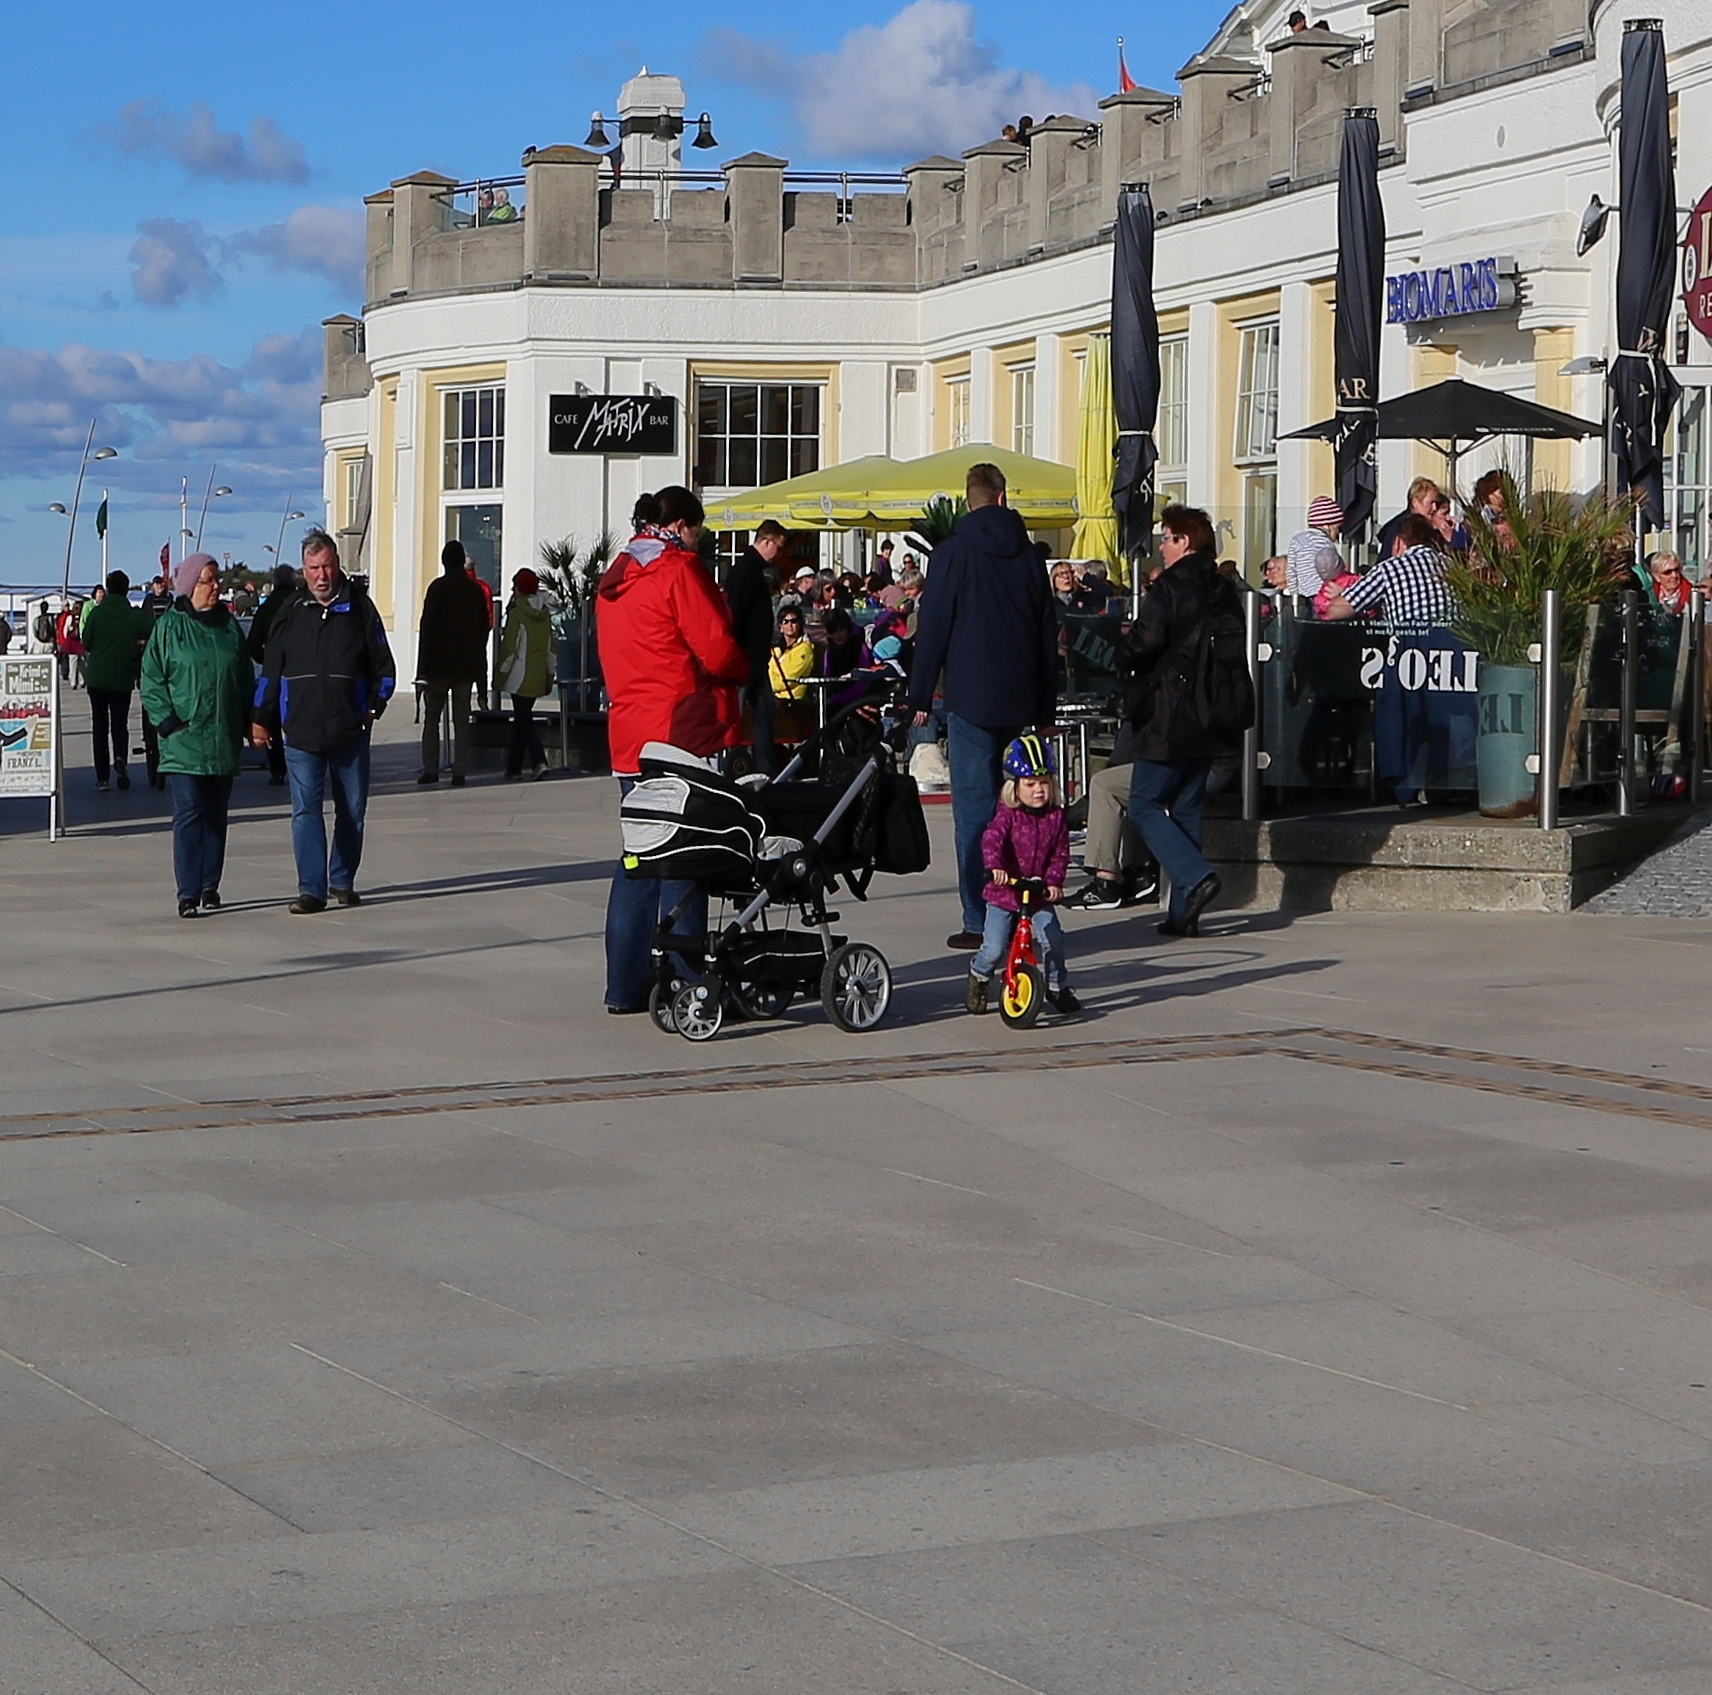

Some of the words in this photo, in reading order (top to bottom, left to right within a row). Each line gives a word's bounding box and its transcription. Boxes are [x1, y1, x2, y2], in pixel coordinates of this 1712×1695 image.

[1386, 257, 1498, 324] BIOMARIS
[554, 414, 578, 424] CAFE
[650, 415, 669, 425] BAR
[19, 664, 41, 678] Krimi
[9, 676, 34, 693] Mimi
[7, 757, 33, 768] FRANZ
